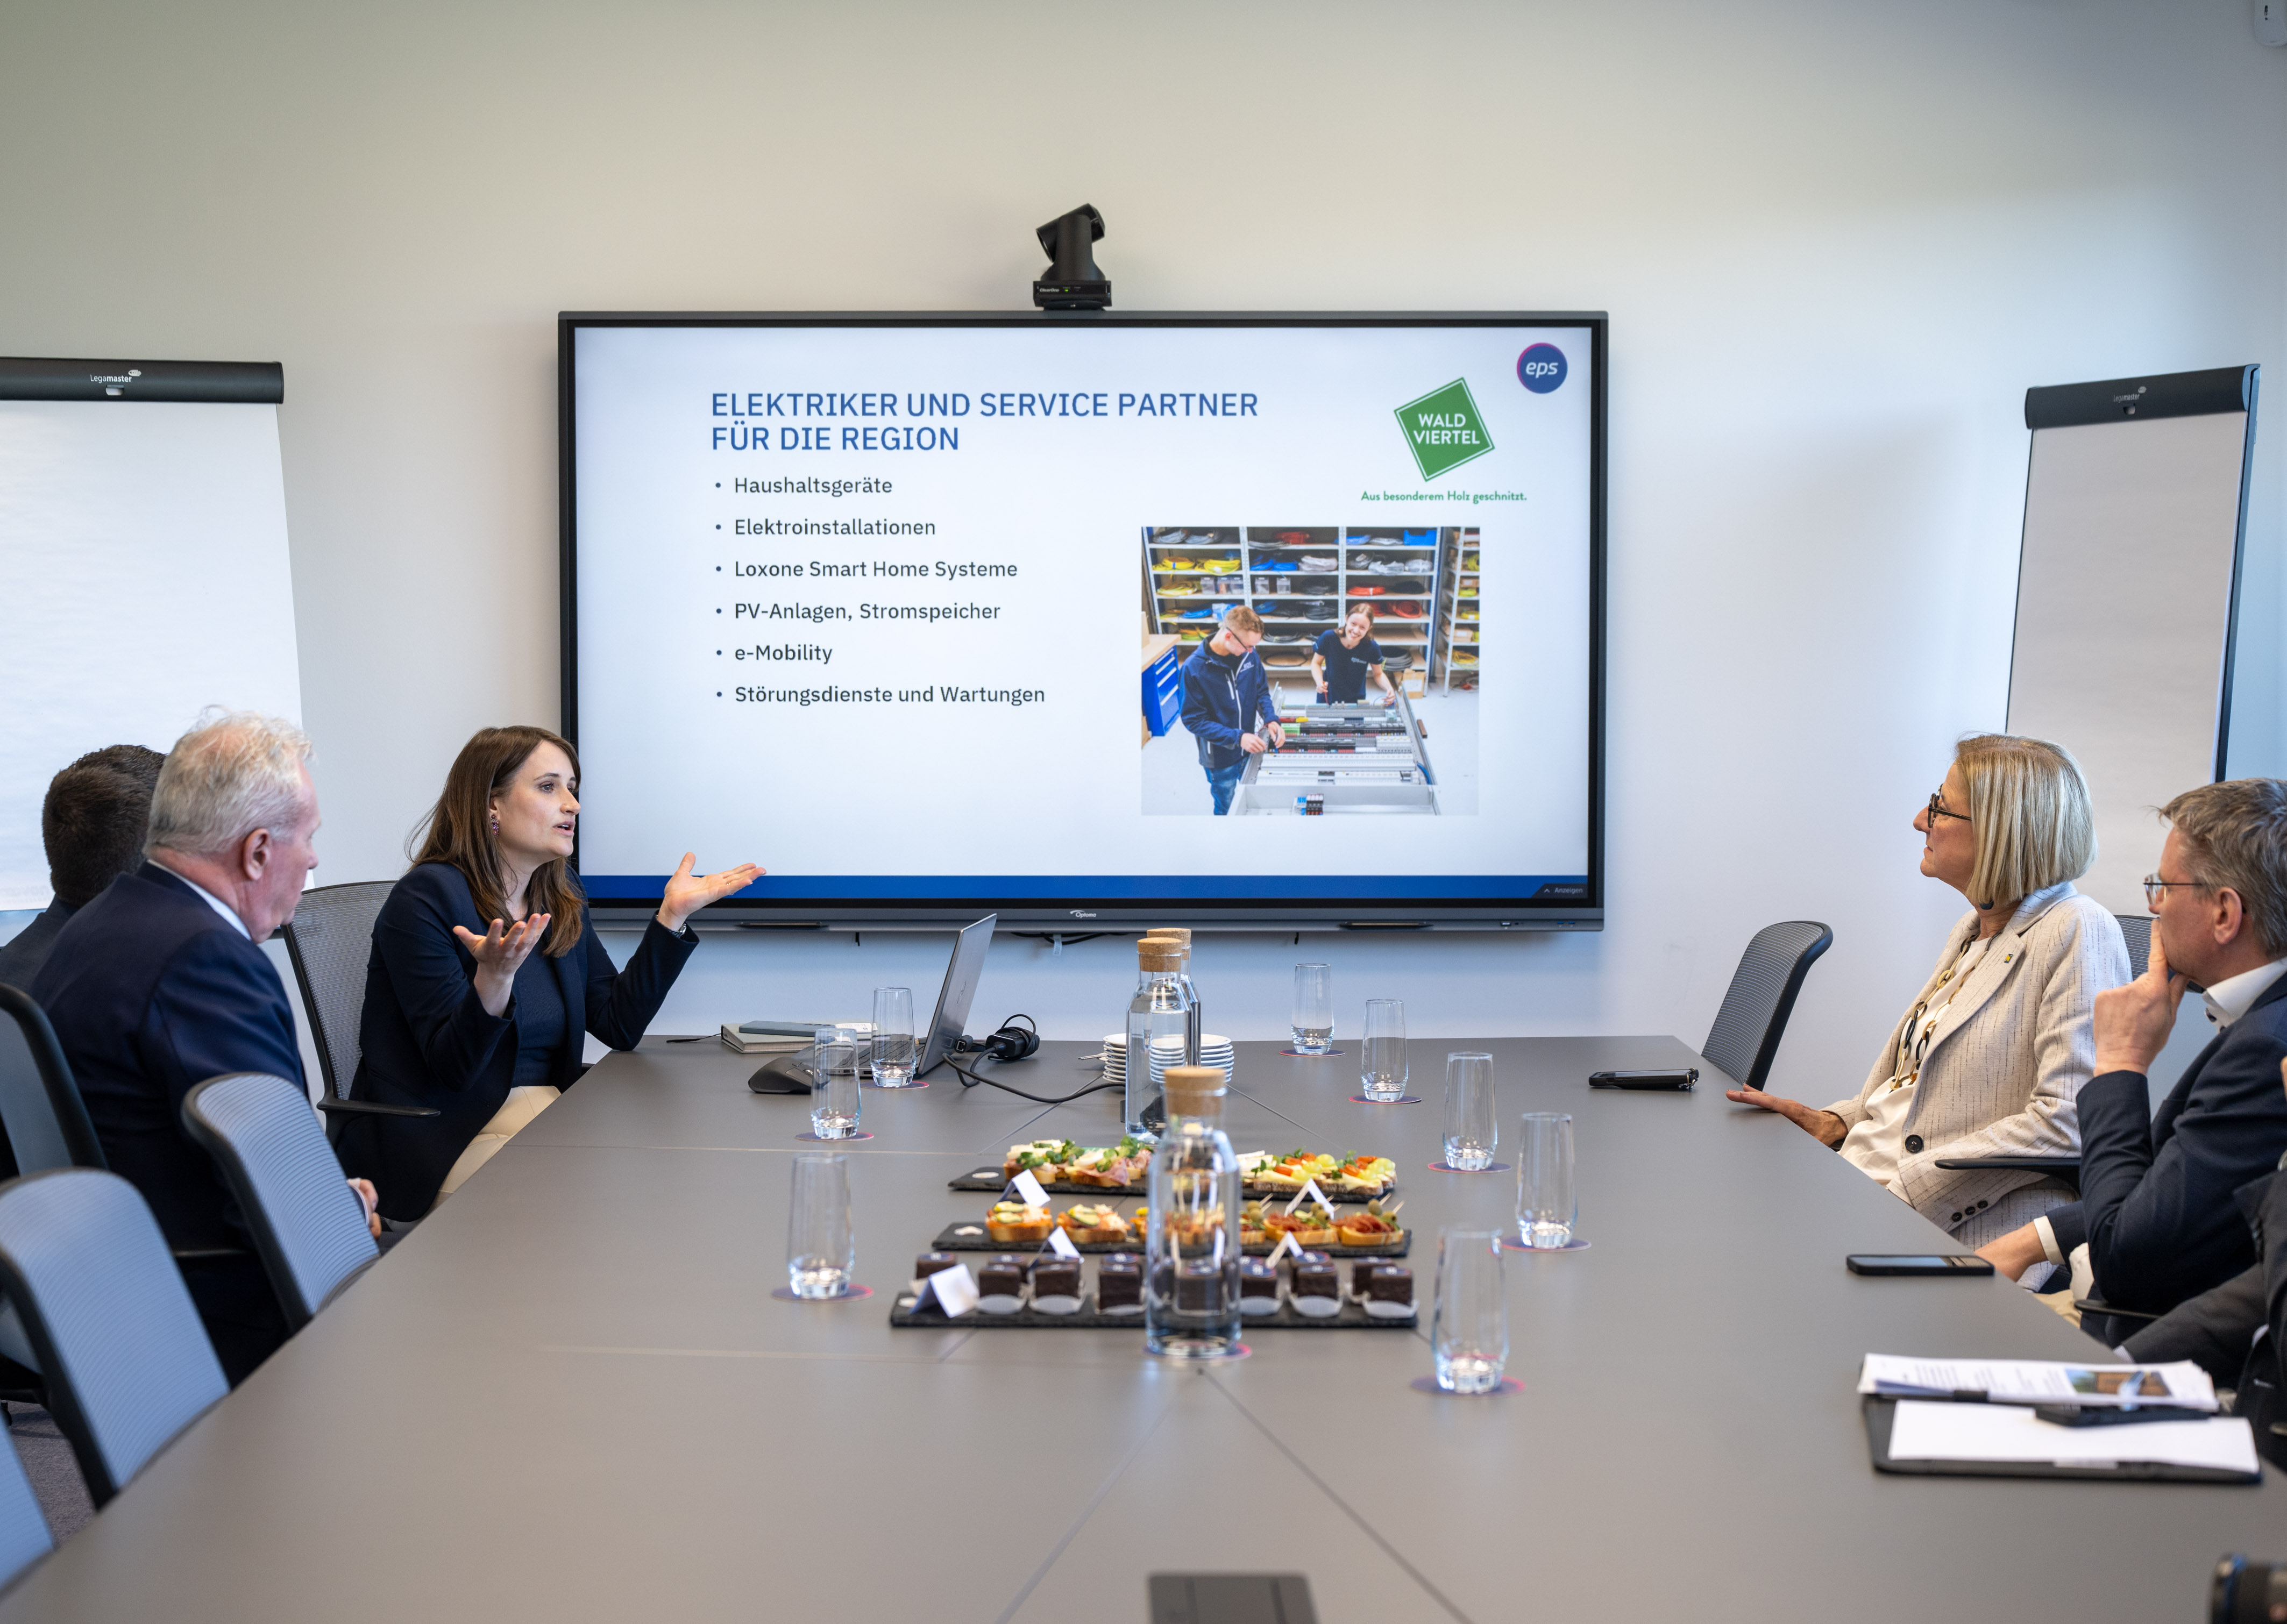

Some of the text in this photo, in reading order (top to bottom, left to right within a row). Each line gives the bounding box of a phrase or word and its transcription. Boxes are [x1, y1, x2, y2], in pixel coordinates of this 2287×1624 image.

[90, 374, 132, 383] Legamaster
[1526, 362, 1558, 379] eps
[712, 393, 1258, 417] ELEKTRIKER UND SERVICE PARTNER
[2113, 393, 2140, 403] Legamaster
[1418, 413, 1466, 428] WALD
[713, 420, 958, 451] FÜR DIE REGION
[1414, 430, 1480, 444] VIERTEL
[735, 476, 892, 497] Haushaltsgeräte
[1361, 490, 1528, 505] Aus besonderem Holz geschnitzt.
[735, 518, 935, 535] Elektroinstallationen
[735, 561, 1018, 581] Loxone Smart Home Systeme
[735, 602, 1001, 623] PV-Anlagen, Stromspeicher
[735, 644, 833, 665] e-Mobility
[735, 685, 1045, 707] Störungsdienste und Wartungen
